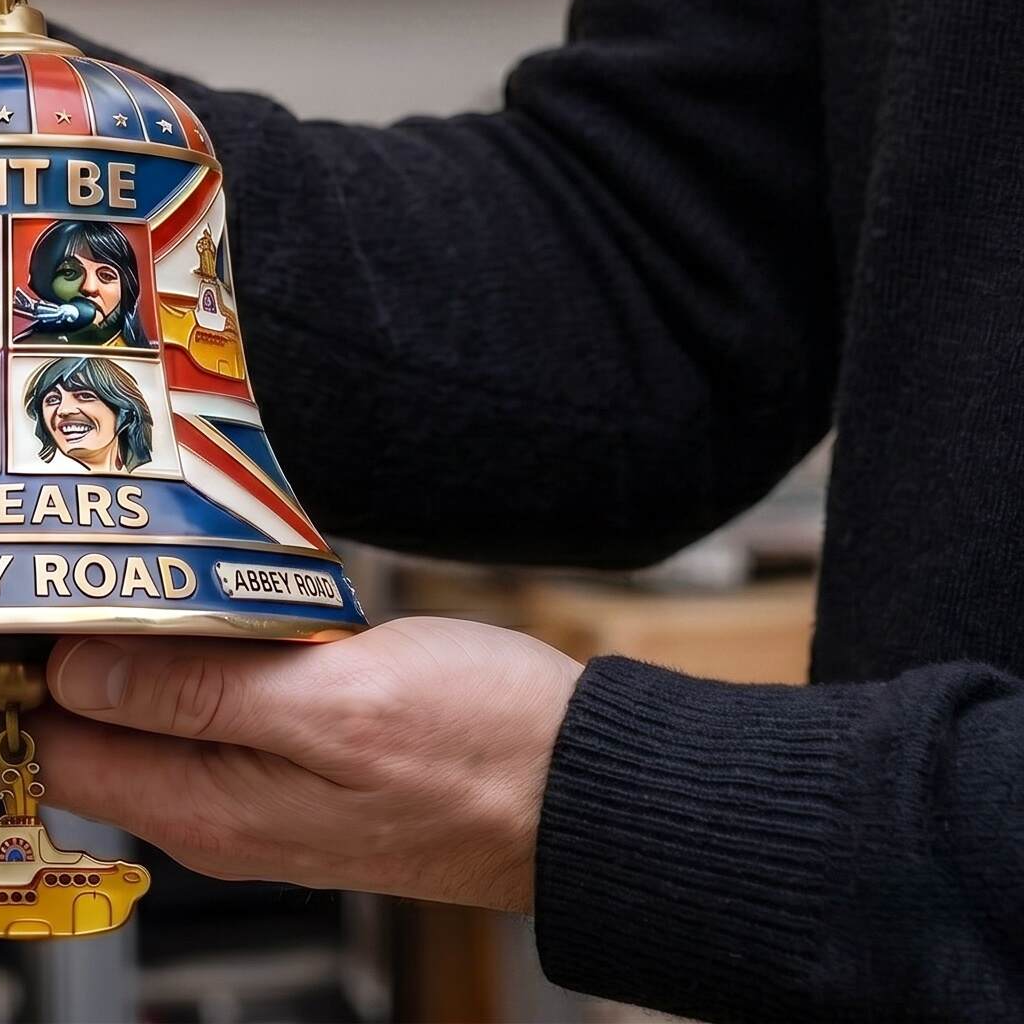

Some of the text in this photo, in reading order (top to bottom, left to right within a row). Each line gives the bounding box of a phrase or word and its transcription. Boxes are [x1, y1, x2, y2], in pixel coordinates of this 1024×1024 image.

[67, 159, 137, 210] BE
[33, 552, 198, 601] ROAD
[234, 569, 335, 599] ABBEY ROAD
